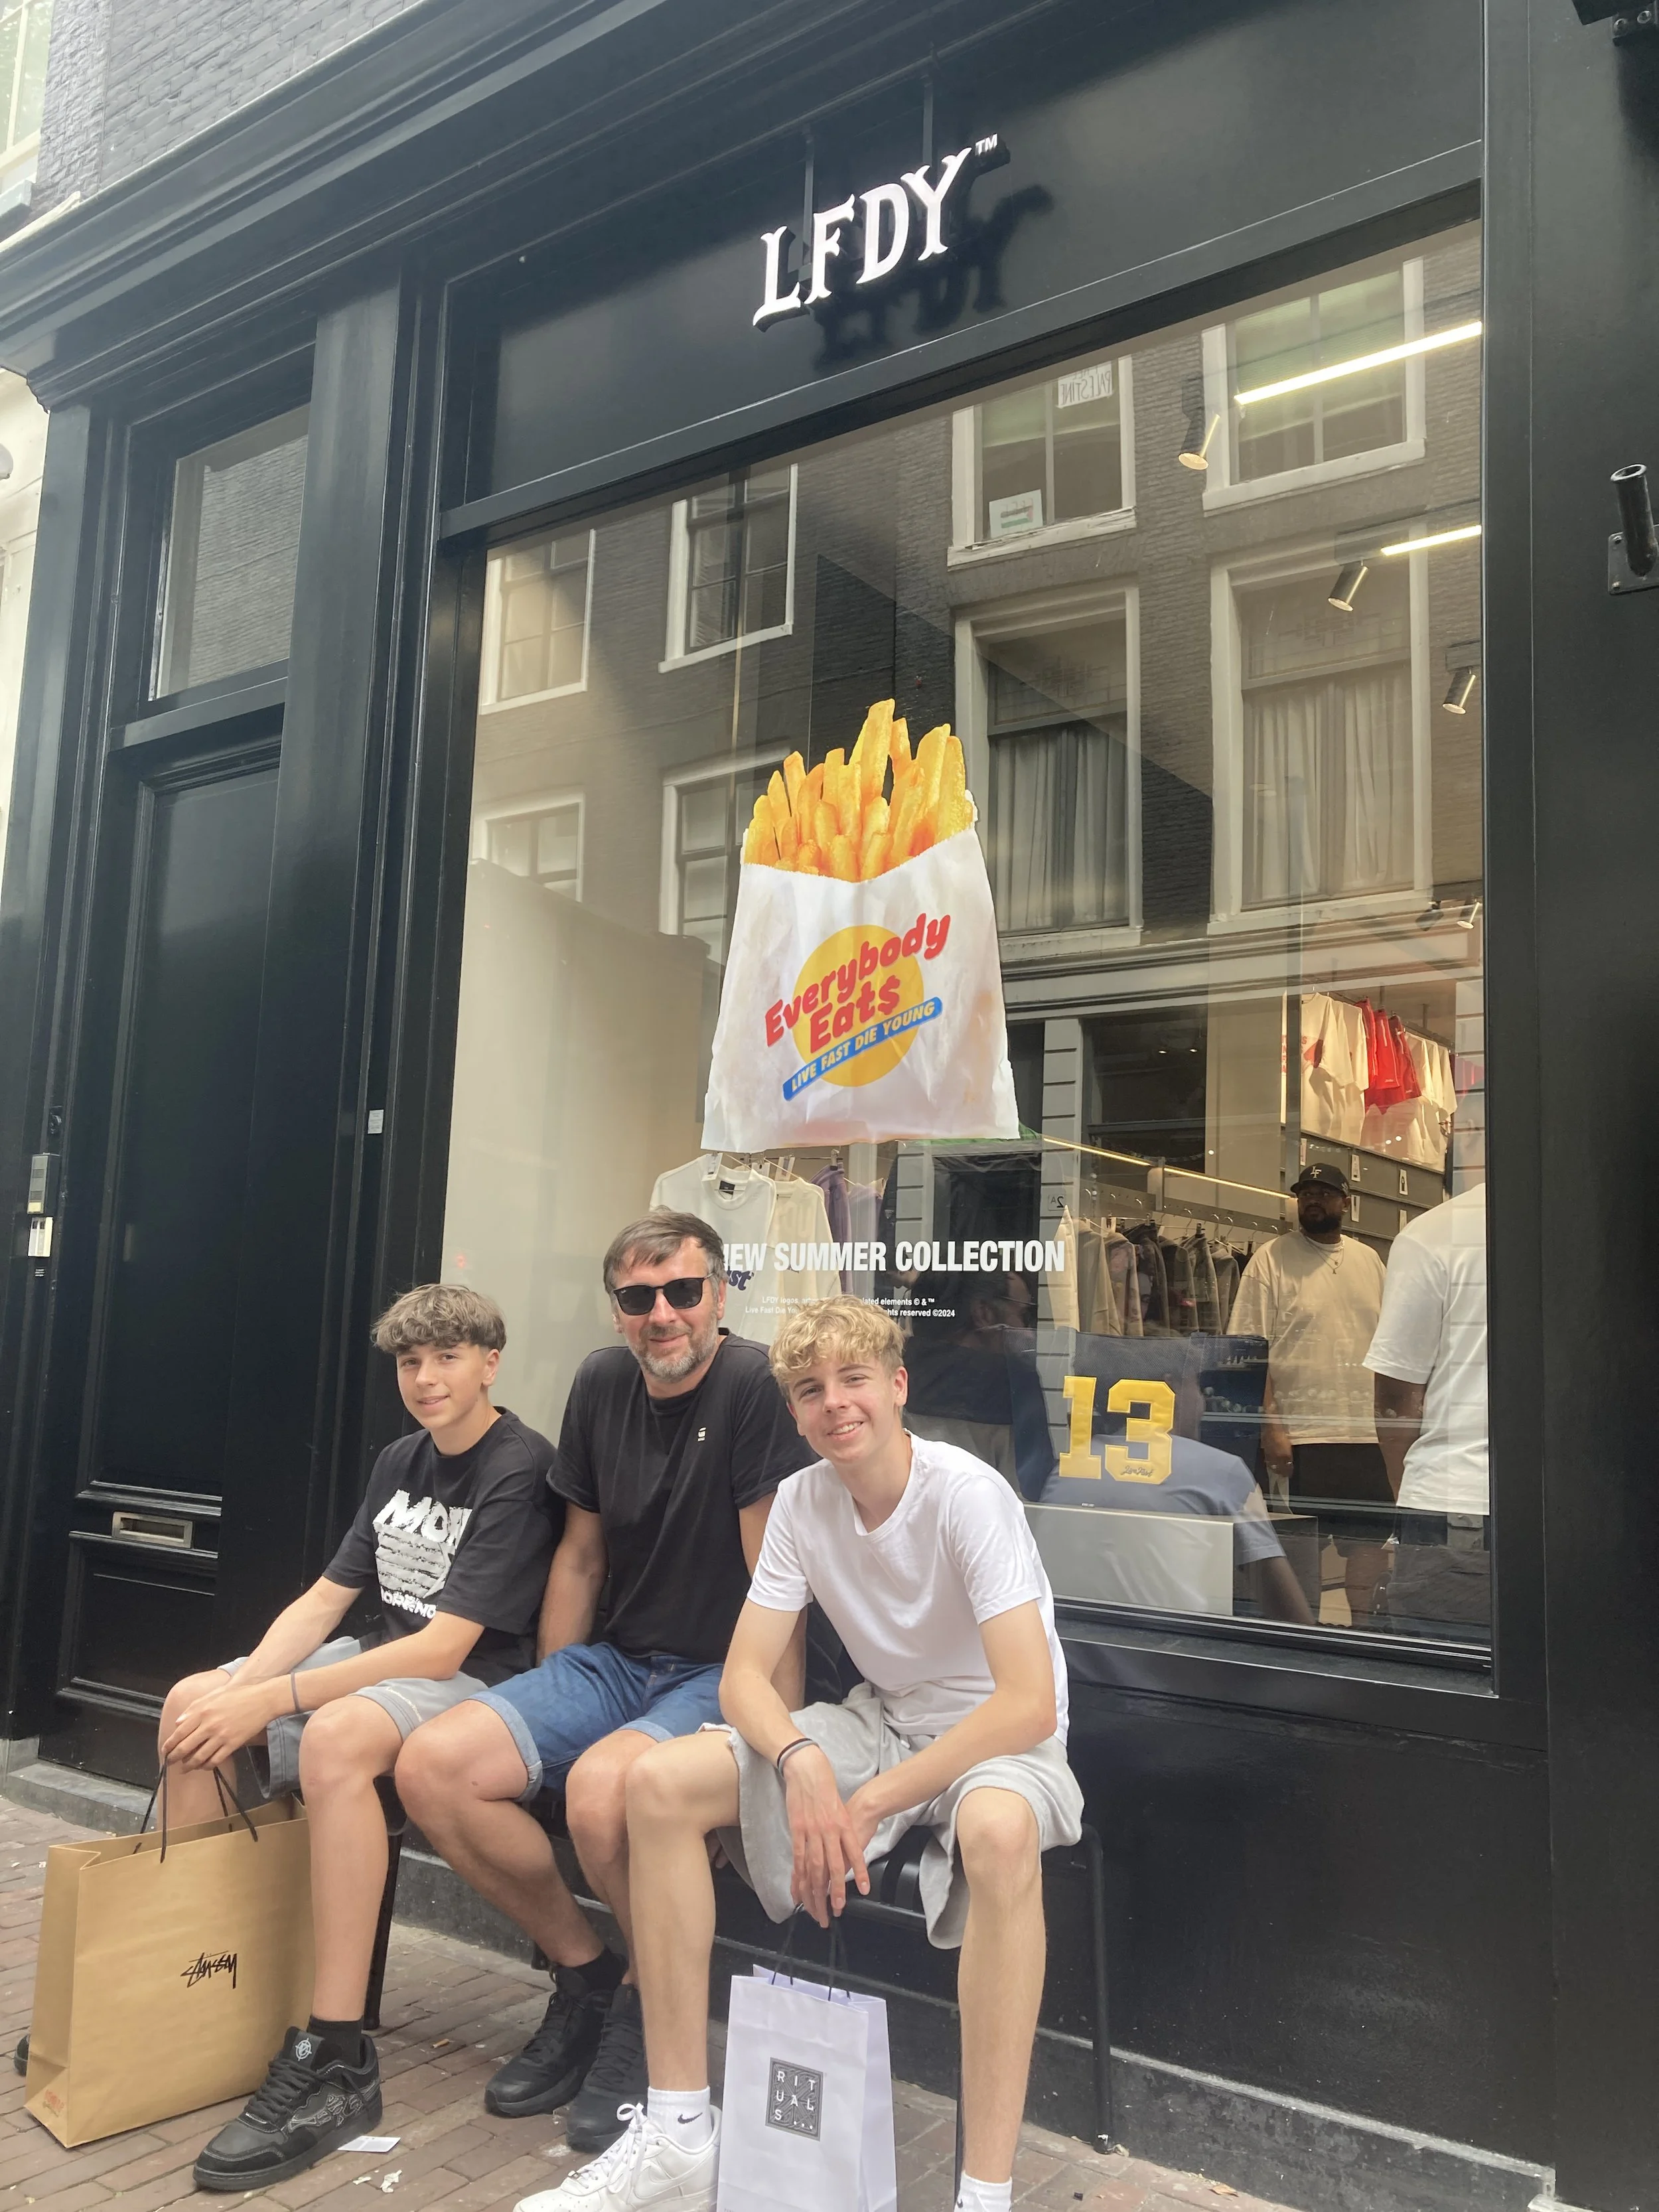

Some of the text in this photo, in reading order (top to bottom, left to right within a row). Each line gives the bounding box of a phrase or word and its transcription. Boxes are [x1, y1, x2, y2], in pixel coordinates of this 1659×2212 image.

[764, 913, 951, 1047] Everybody
[792, 1001, 935, 1092] LIVE FAST DIE YOUNG
[774, 1242, 887, 1272] SUMMER
[895, 1240, 1065, 1272] COLLECTION
[1058, 1375, 1176, 1485] 13
